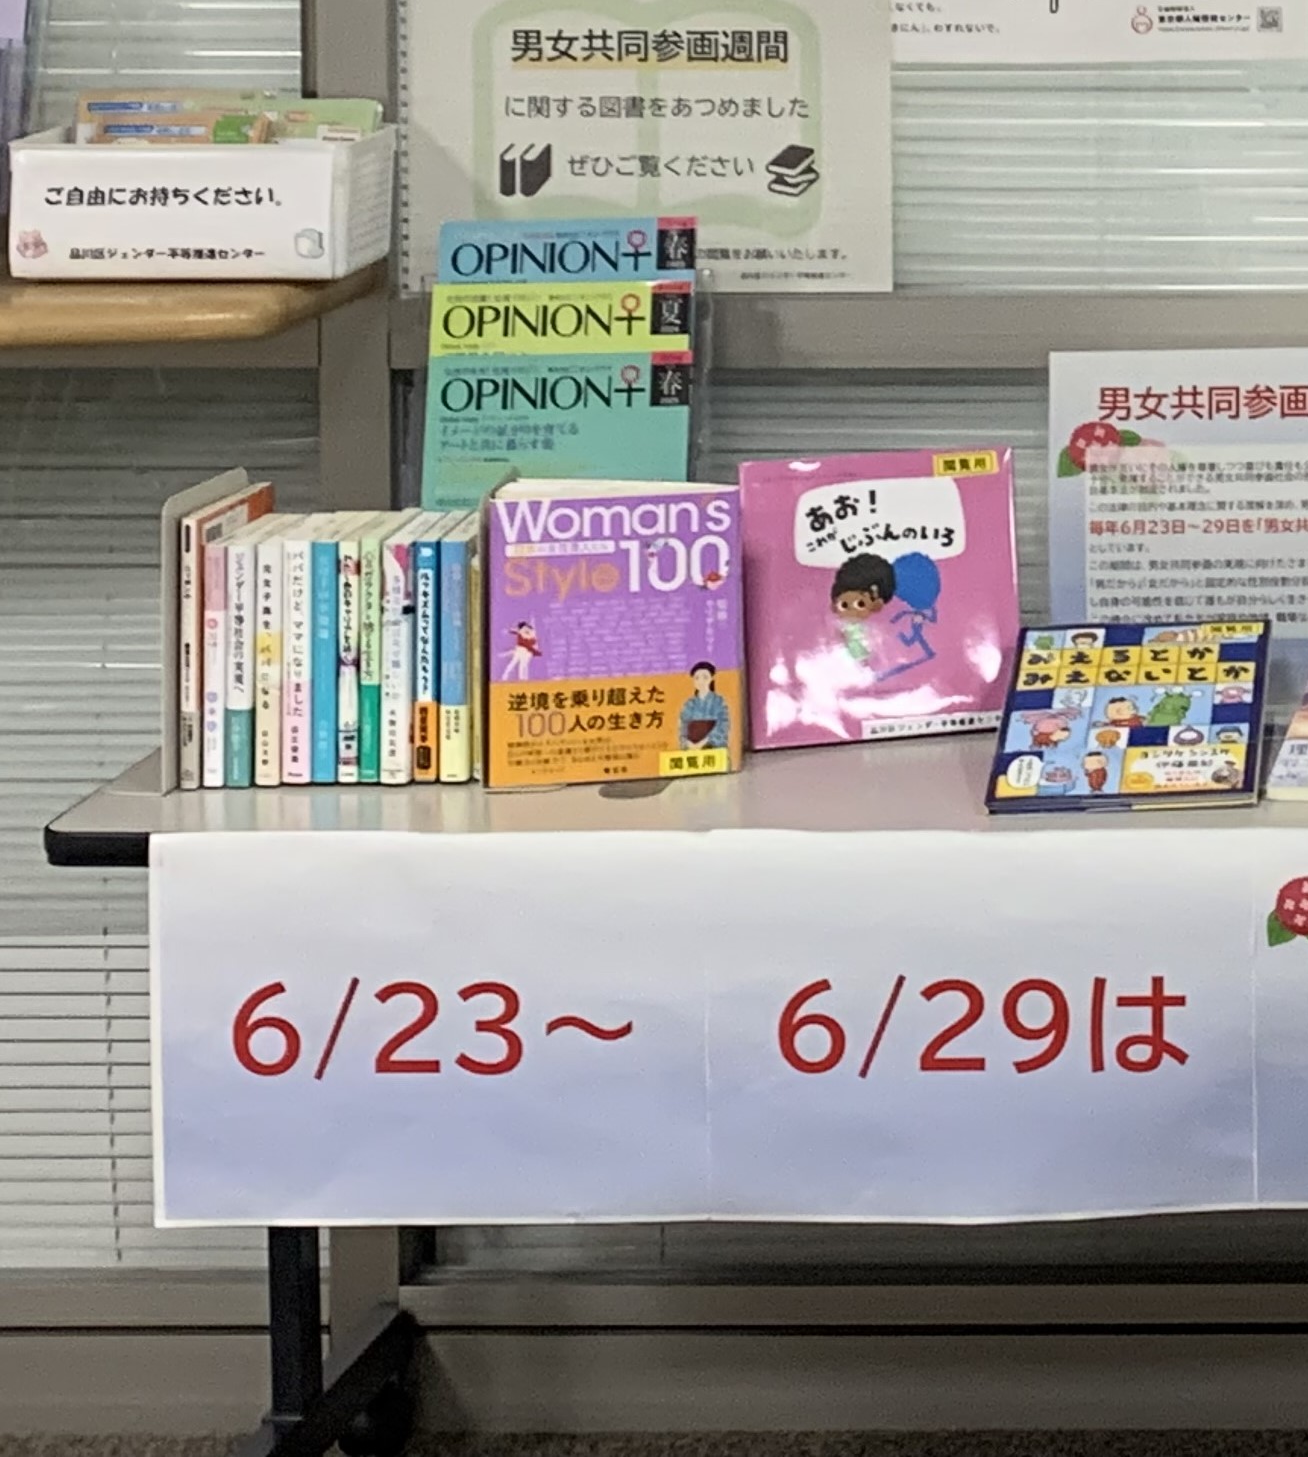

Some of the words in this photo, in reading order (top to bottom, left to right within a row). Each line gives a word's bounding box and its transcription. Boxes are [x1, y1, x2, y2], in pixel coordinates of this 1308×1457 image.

[511, 29, 789, 63] 男女共同参画週間
[505, 96, 809, 119] に関する図書をあつめました
[568, 155, 755, 178] ぜひご覧ください
[44, 185, 283, 208] ご自由にお持ちください。
[451, 239, 619, 276] OPINION
[442, 303, 613, 339] OPINION
[440, 376, 613, 413] OPINION
[805, 490, 878, 533] あお！
[839, 523, 955, 554] じぶんのいろ
[618, 535, 730, 593] 100
[508, 686, 665, 712] 逆境を乗り超えた
[516, 710, 665, 738] 100人の生き方
[777, 975, 1190, 1078] 6/29は
